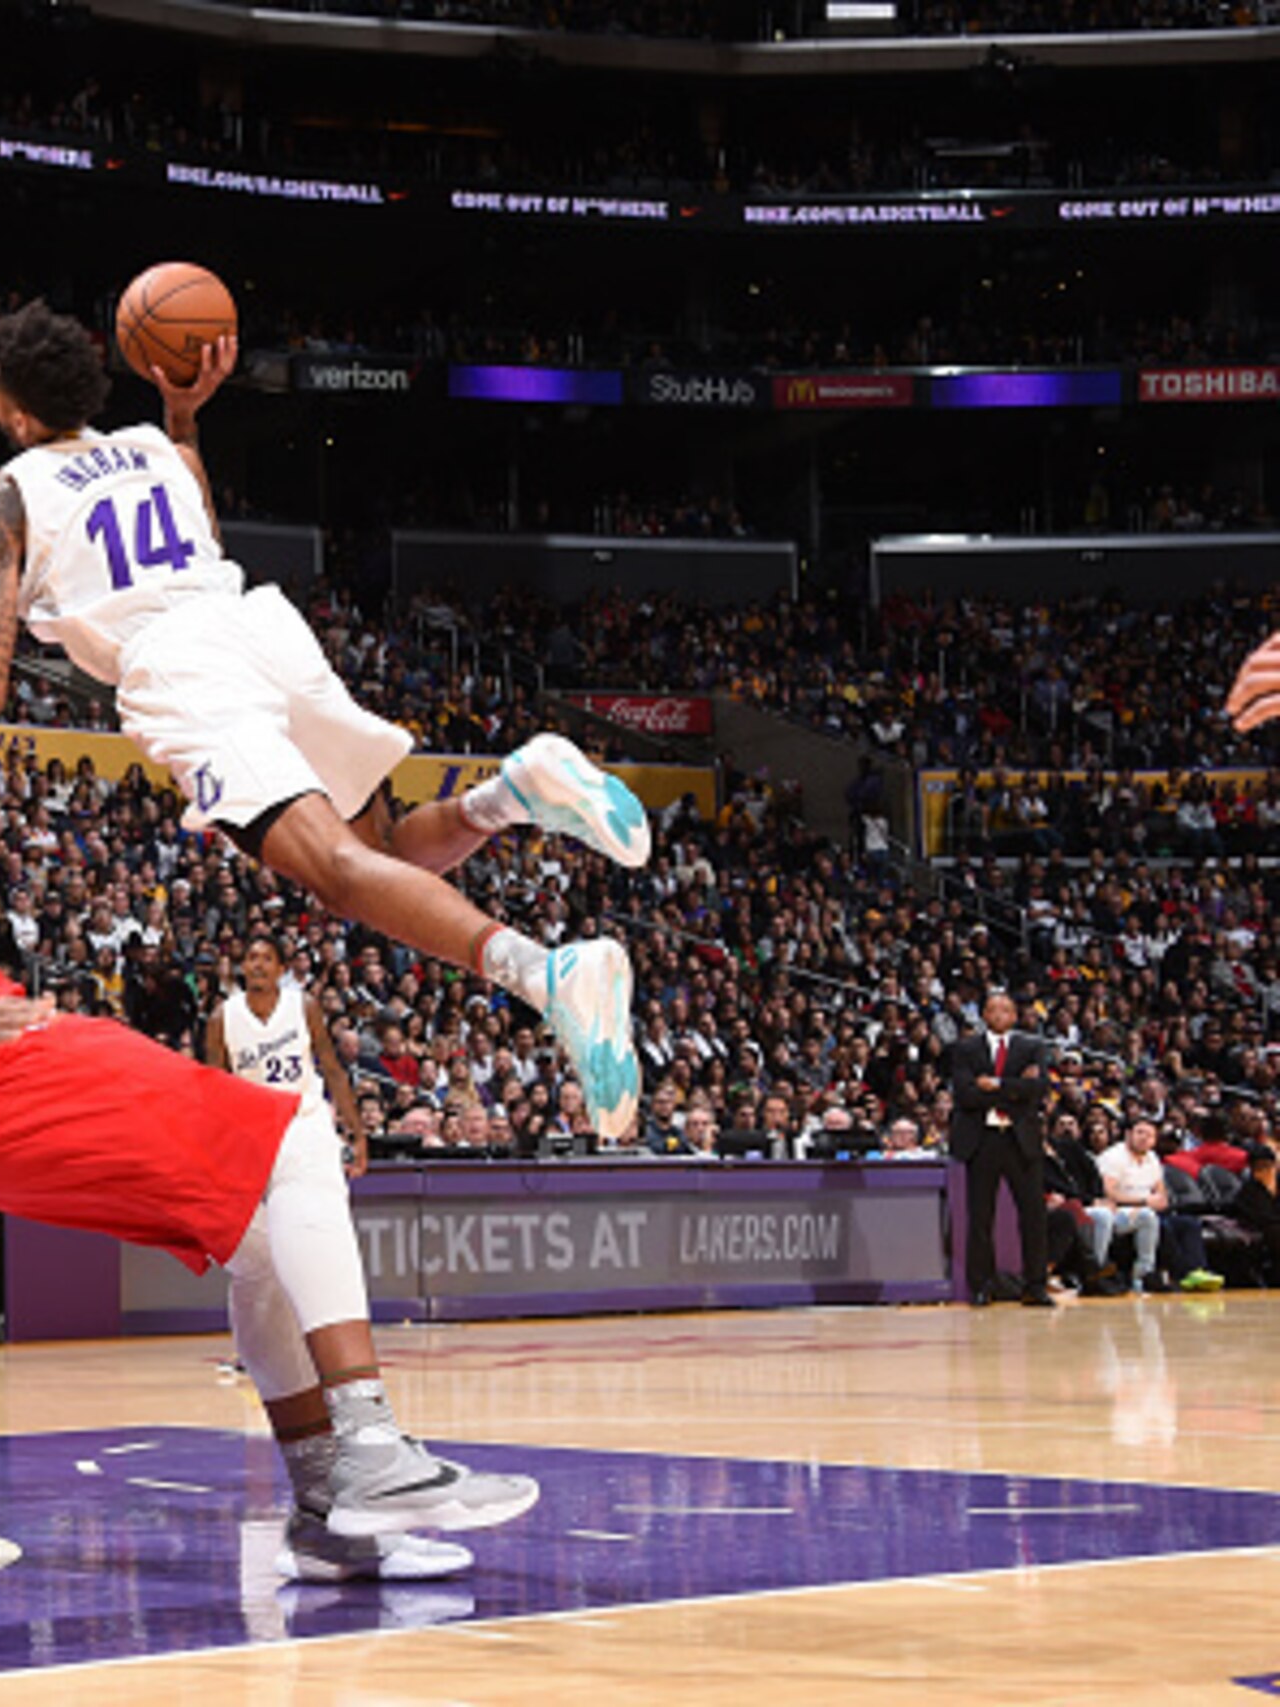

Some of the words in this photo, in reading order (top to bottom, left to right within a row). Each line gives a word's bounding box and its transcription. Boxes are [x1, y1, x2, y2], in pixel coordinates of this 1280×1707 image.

[311, 362, 409, 391] verizon
[650, 373, 756, 404] StubHub
[1142, 371, 1280, 398] TOSHIBA
[55, 447, 150, 492] INGRAM
[85, 484, 196, 591] 14
[266, 1054, 302, 1083] 23
[359, 1212, 574, 1277] TICKETS
[589, 1213, 647, 1268] AT
[679, 1213, 840, 1265] LAKERS.COM
